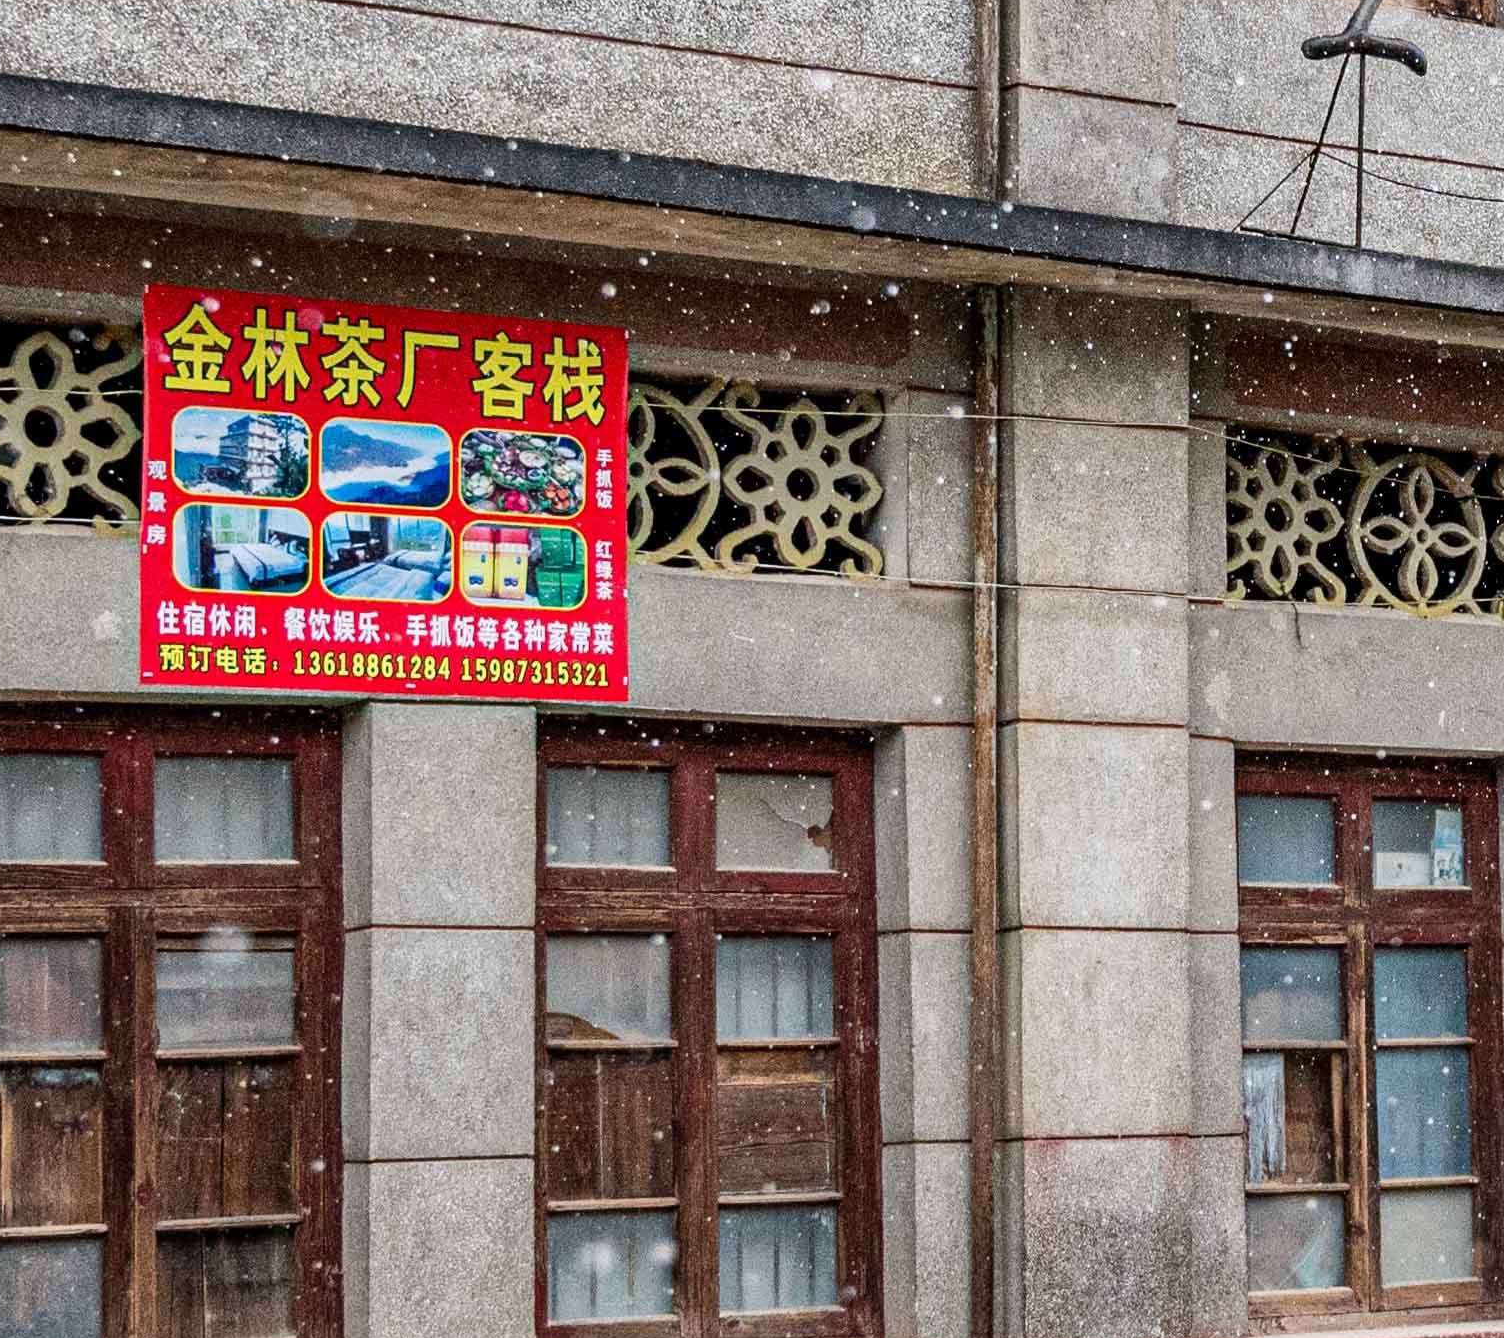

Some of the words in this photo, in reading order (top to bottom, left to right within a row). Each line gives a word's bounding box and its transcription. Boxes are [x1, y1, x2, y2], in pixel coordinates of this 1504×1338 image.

[163, 302, 606, 426] 金林茶厂客栈
[146, 460, 168, 546] 观景房
[594, 448, 614, 511] 手抓饭
[594, 539, 614, 602] 红绿茶
[293, 650, 451, 681] 13618861284
[461, 657, 609, 687] 15987315321
